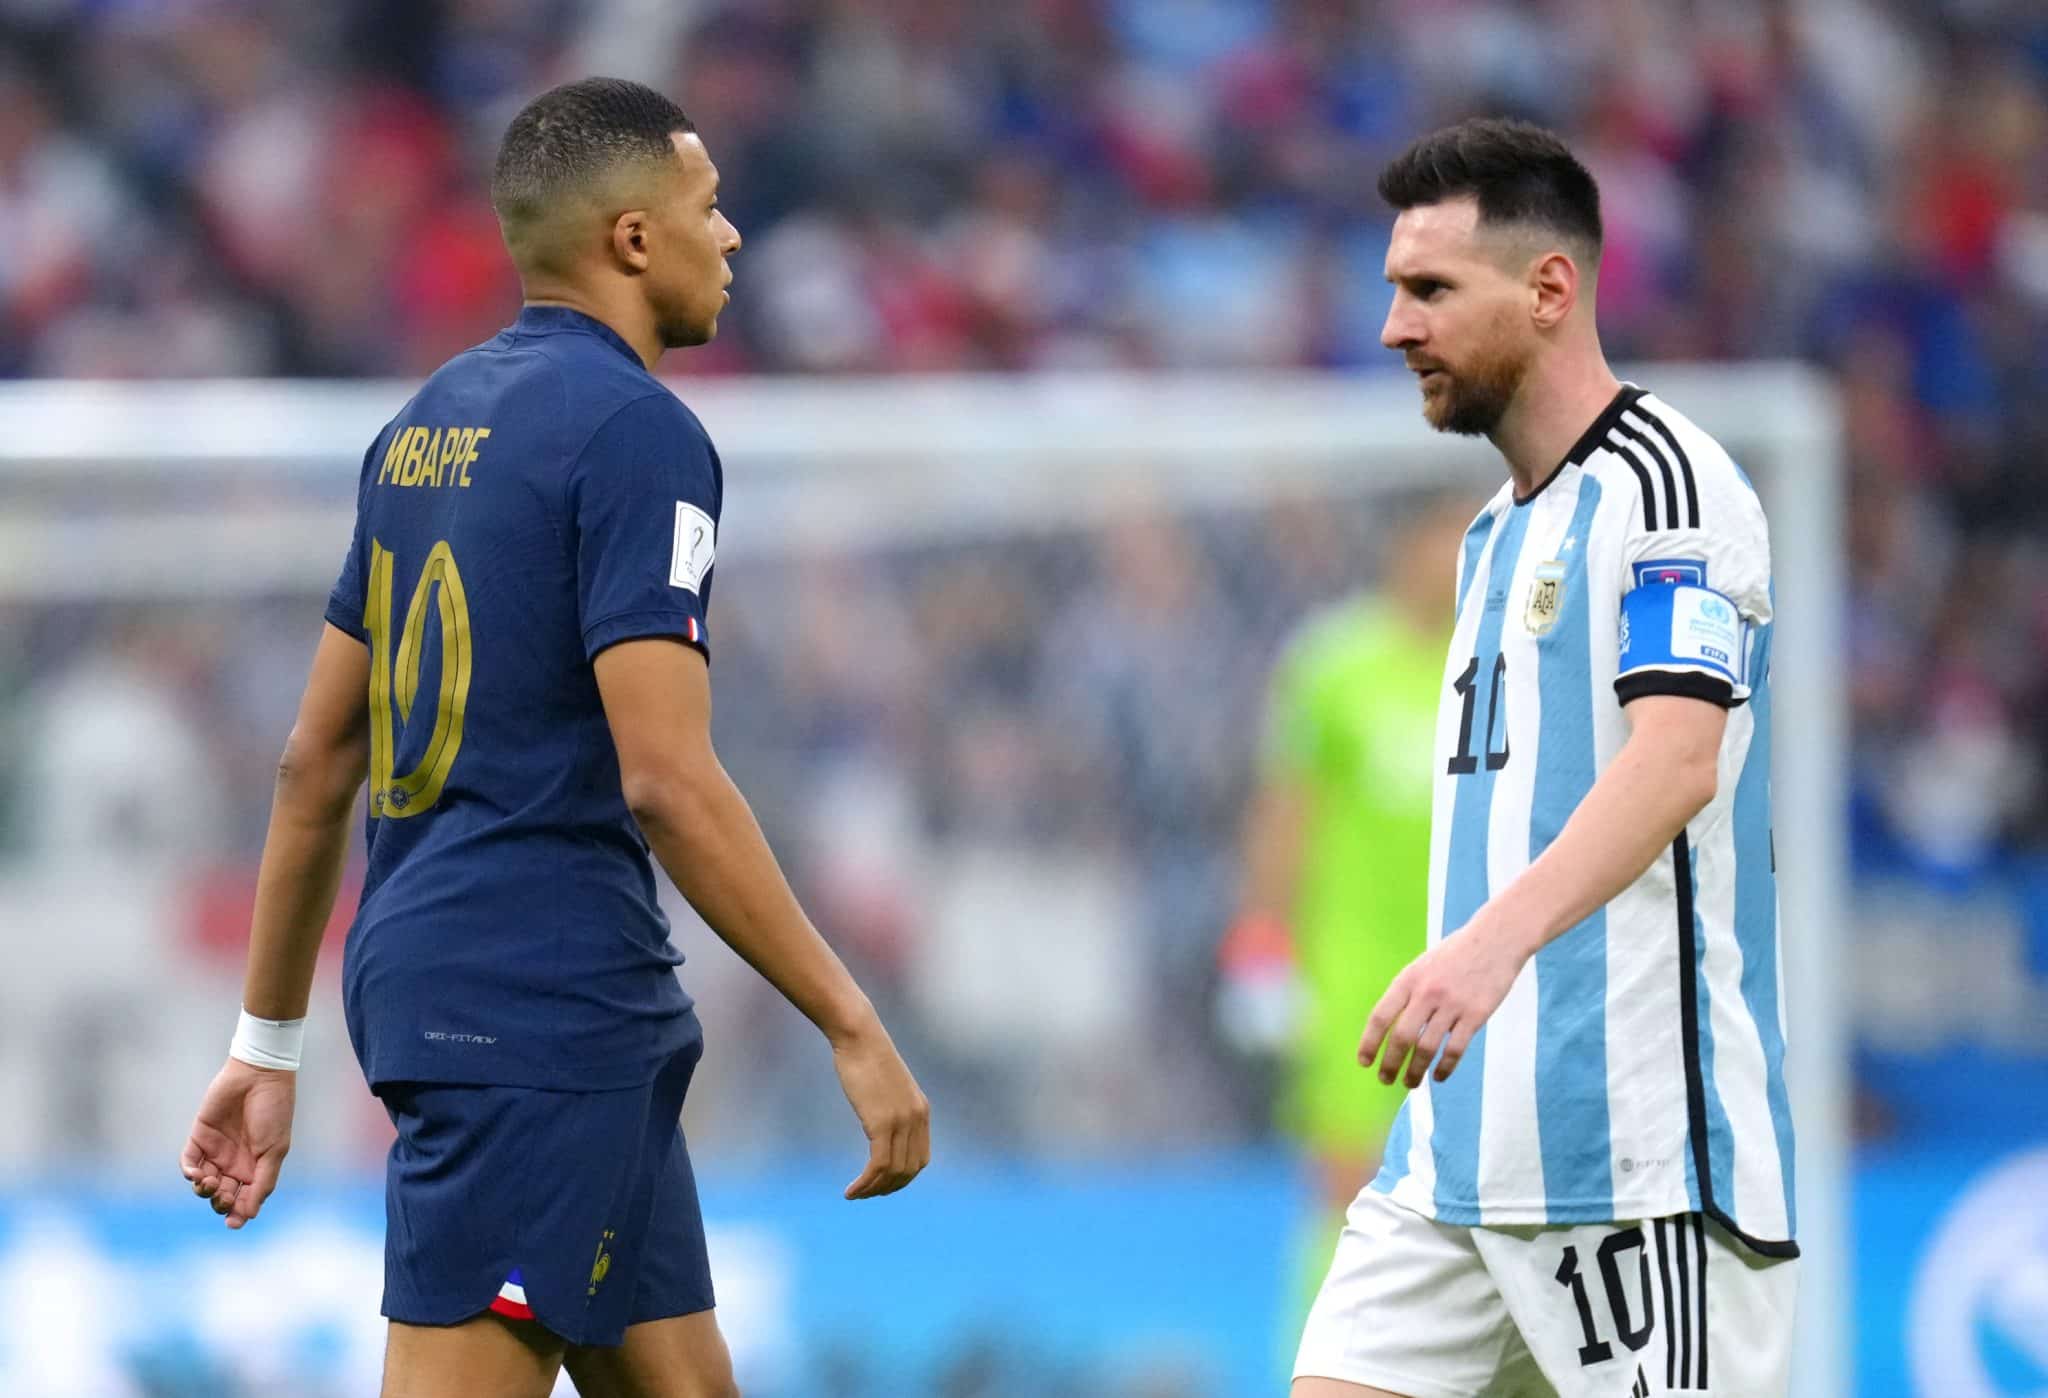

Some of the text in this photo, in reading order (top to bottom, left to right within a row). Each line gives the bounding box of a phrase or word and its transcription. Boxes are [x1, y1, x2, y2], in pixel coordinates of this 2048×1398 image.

[363, 537, 472, 818] 10
[1447, 651, 1510, 776] 10
[1555, 1226, 1655, 1367] 10
